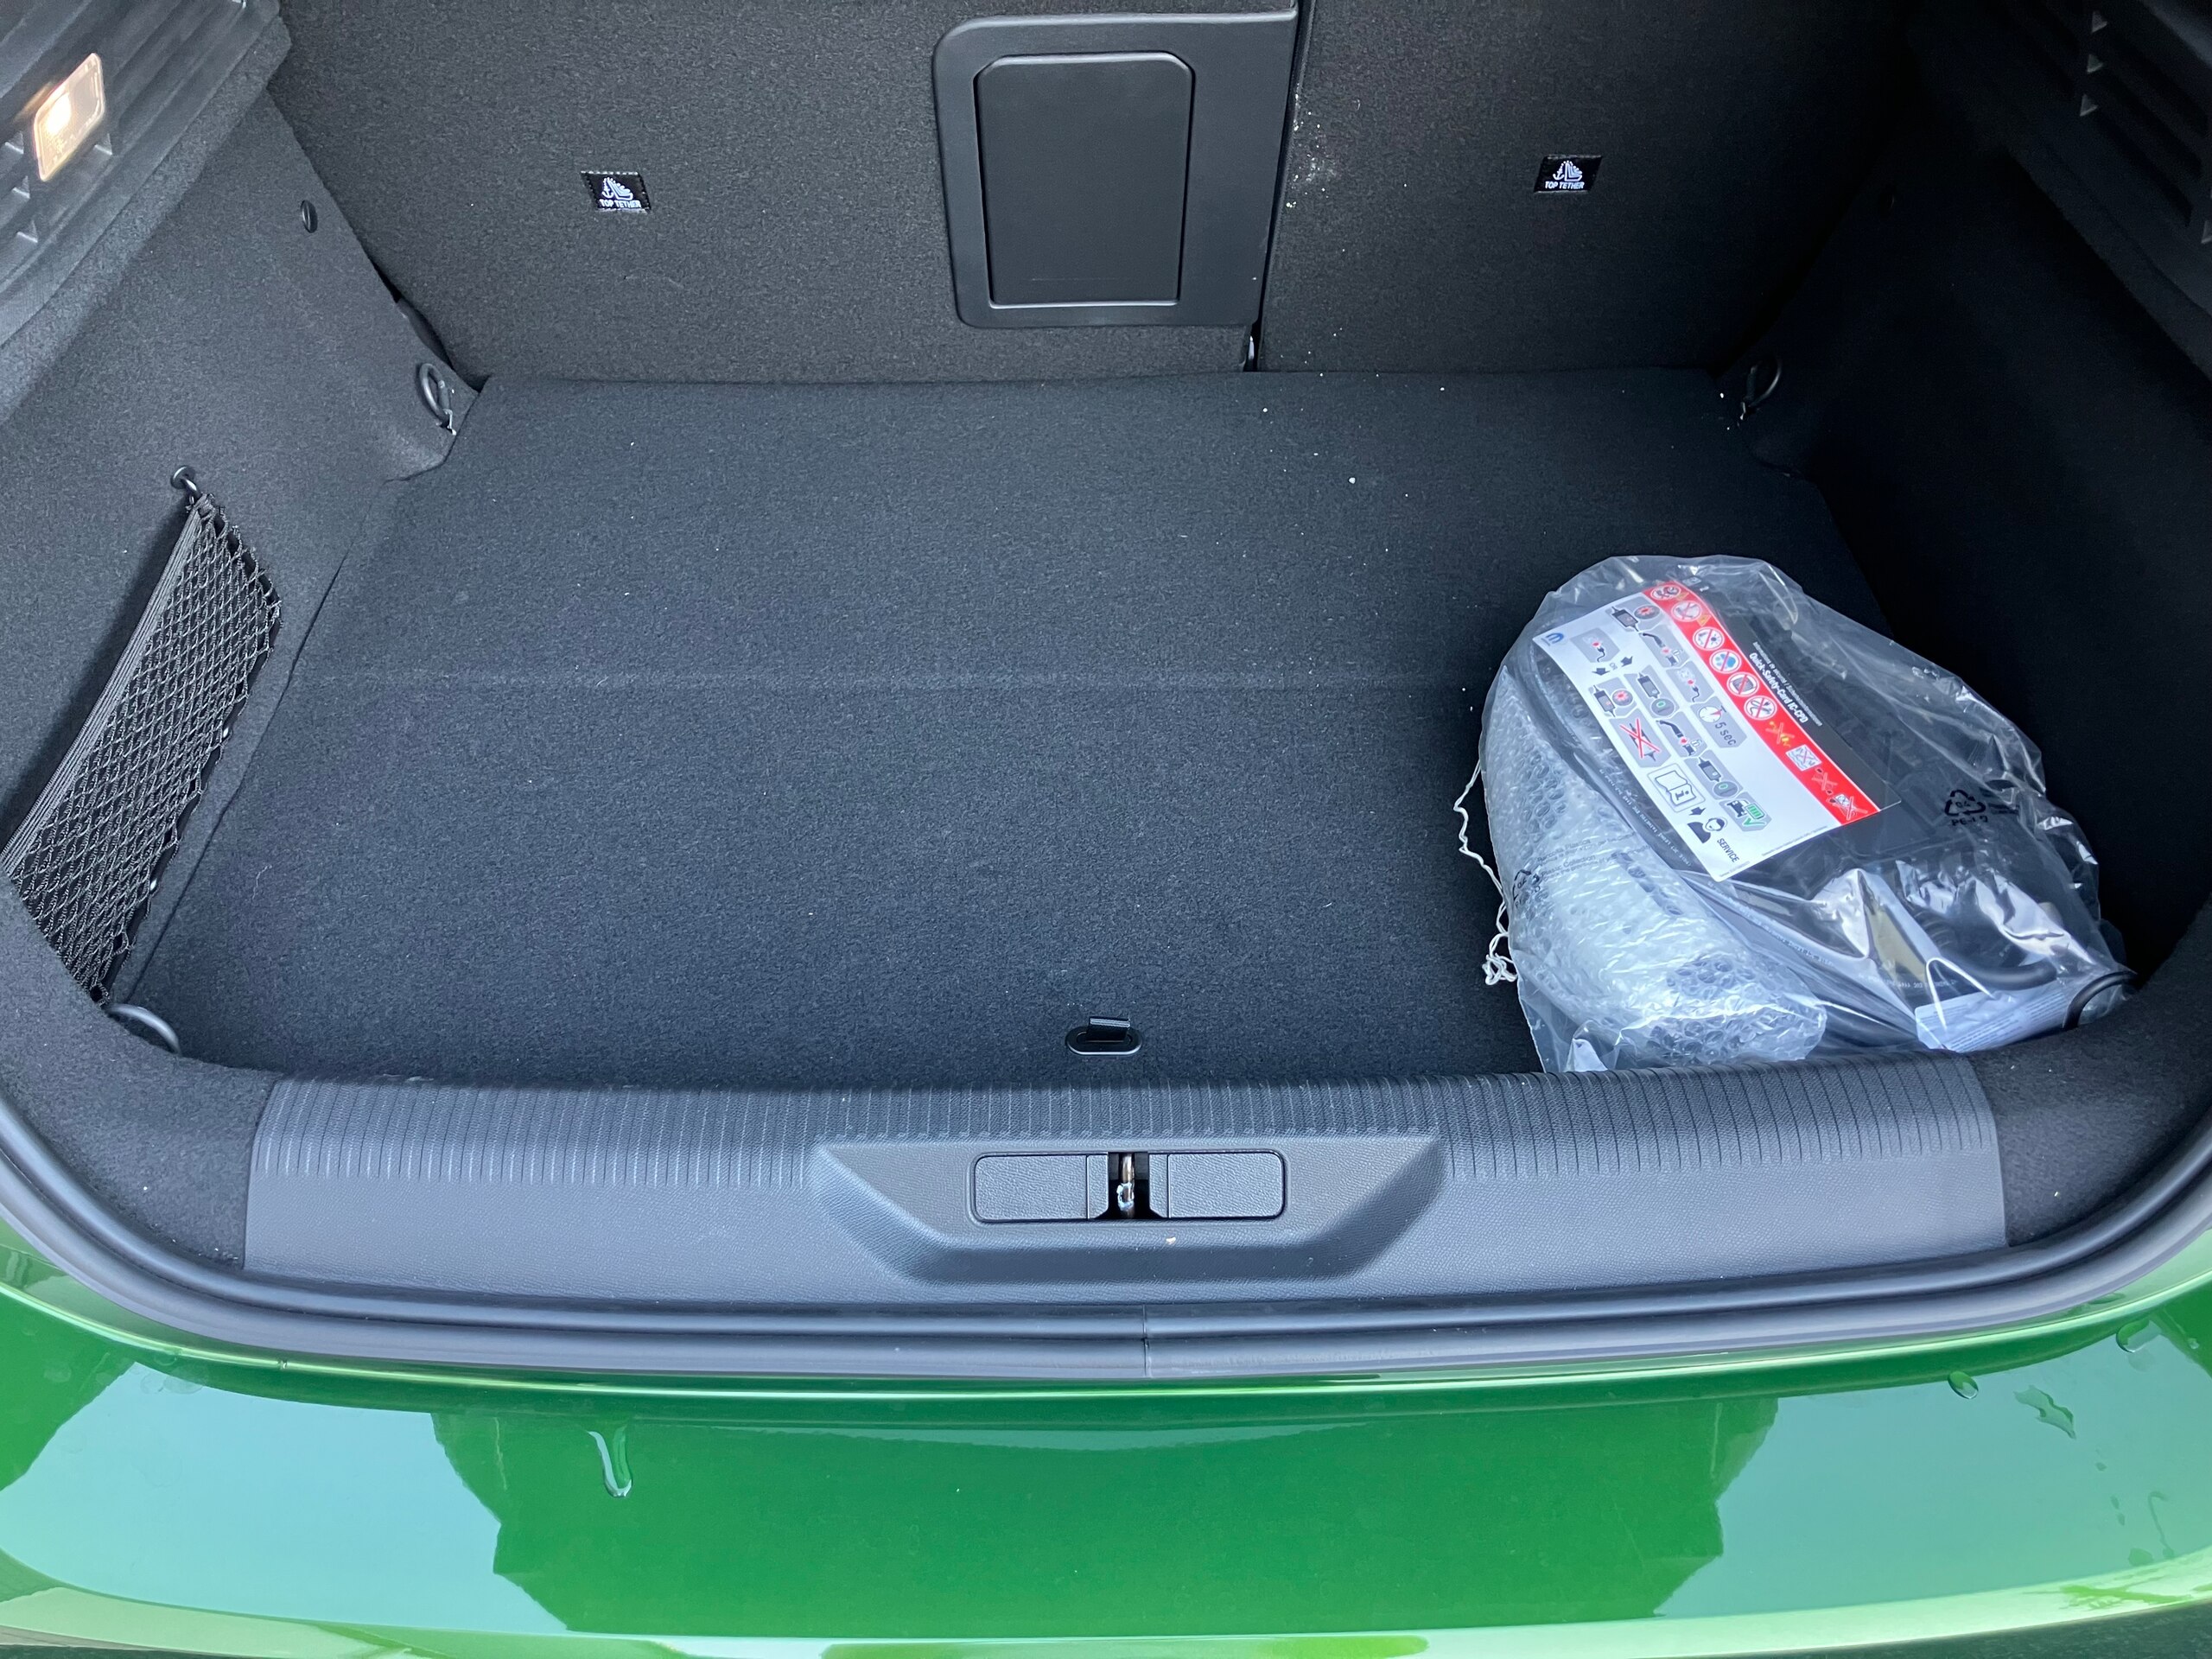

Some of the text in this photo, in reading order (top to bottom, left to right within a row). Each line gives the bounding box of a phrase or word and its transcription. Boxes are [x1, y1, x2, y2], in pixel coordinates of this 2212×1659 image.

[1545, 181, 1585, 189] TOP TETHER
[599, 199, 642, 208] TOP TETHER
[1750, 652, 1808, 723] Quick-Safety-Card IC-CPD
[1715, 721, 1737, 746] 5 sec
[1717, 838, 1739, 862] SERVICE
